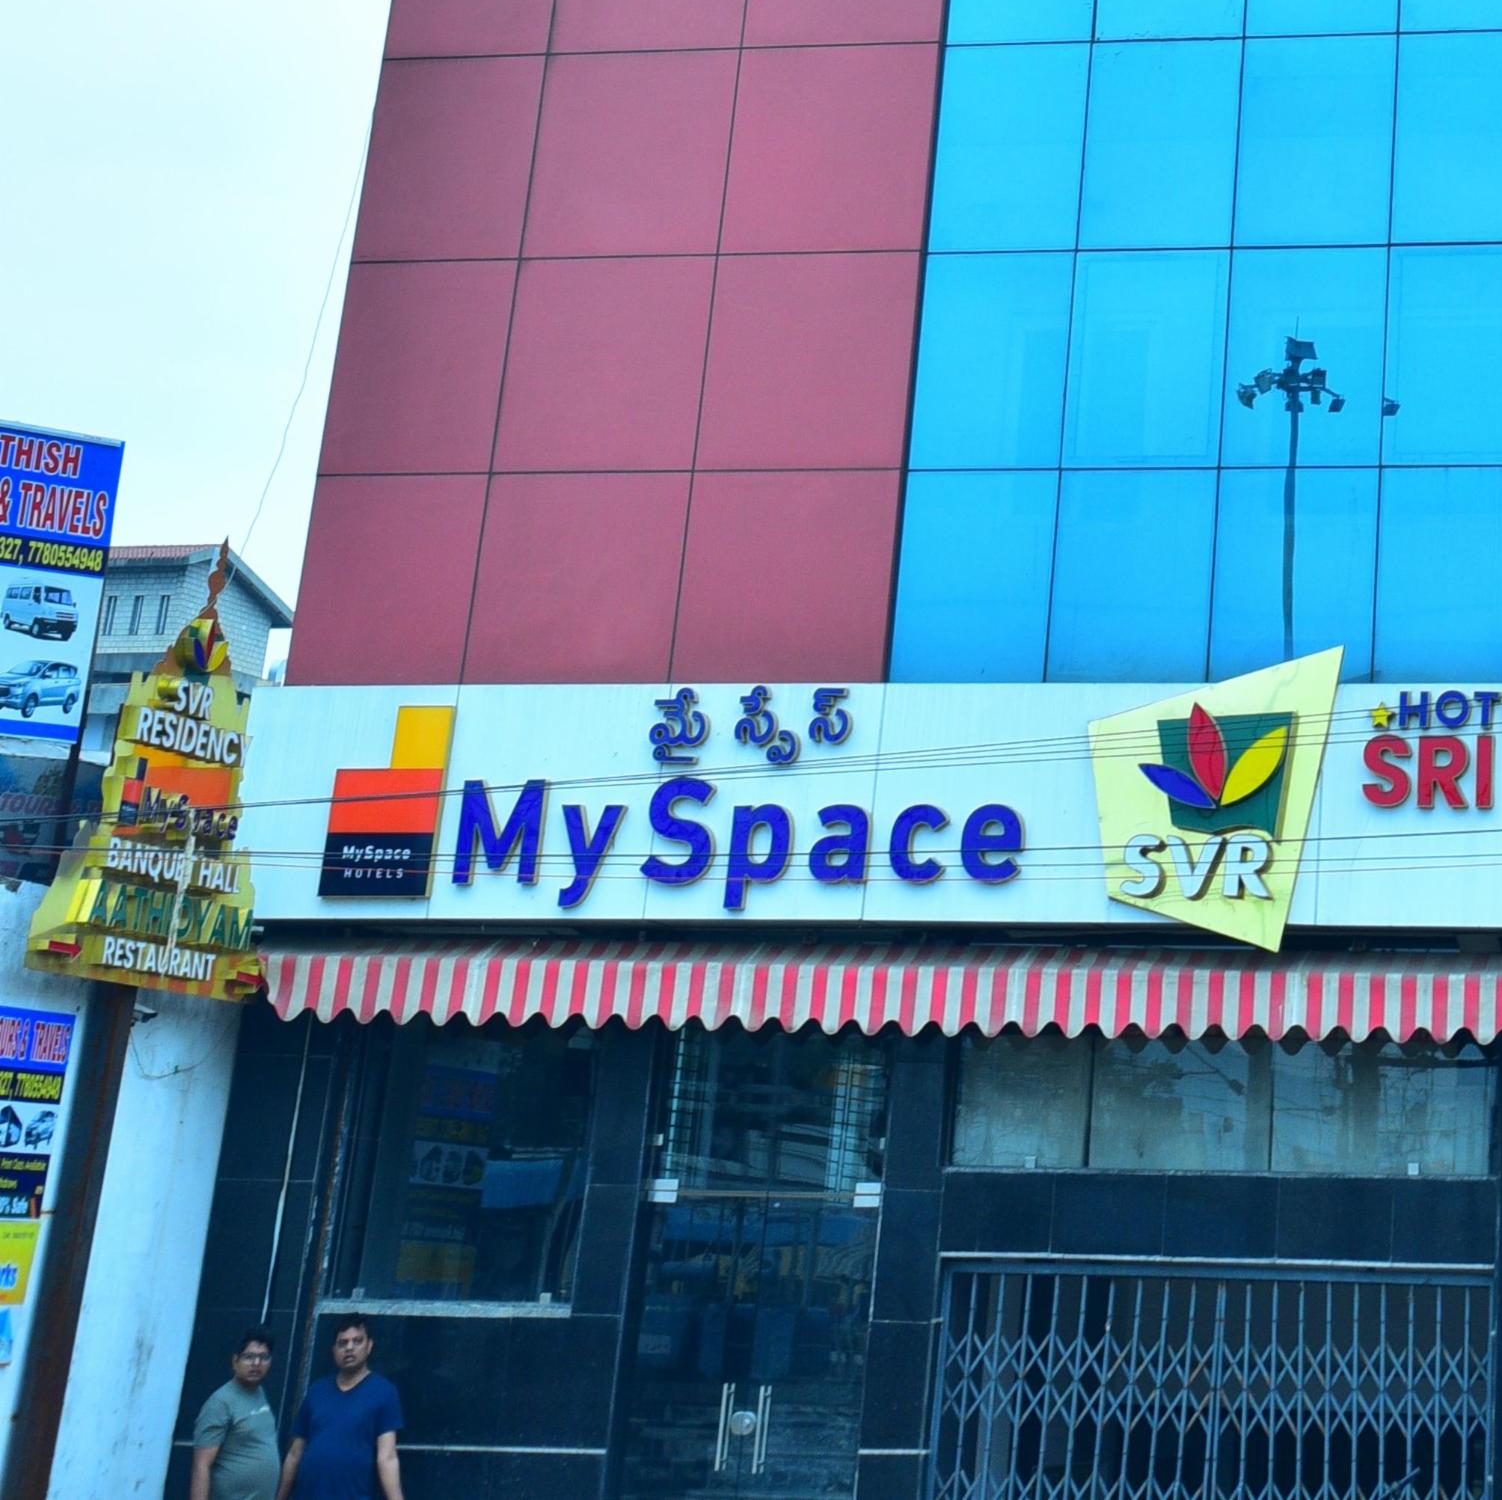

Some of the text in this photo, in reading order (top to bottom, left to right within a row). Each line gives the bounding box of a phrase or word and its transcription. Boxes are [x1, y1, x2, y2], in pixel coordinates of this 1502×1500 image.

[0, 432, 82, 478] THISH
[17, 481, 109, 538] TRAVELS
[28, 541, 104, 572] 7780554948
[174, 678, 214, 721] SVR
[136, 706, 254, 768] RESIDENCY
[1361, 734, 1495, 811] SRI
[341, 844, 412, 863] MySpace
[451, 775, 1024, 910] MySpace
[198, 860, 241, 893] HALL
[343, 867, 405, 879] HOTELS
[1119, 833, 1276, 903] SVR
[102, 936, 217, 982] RESTAURANT
